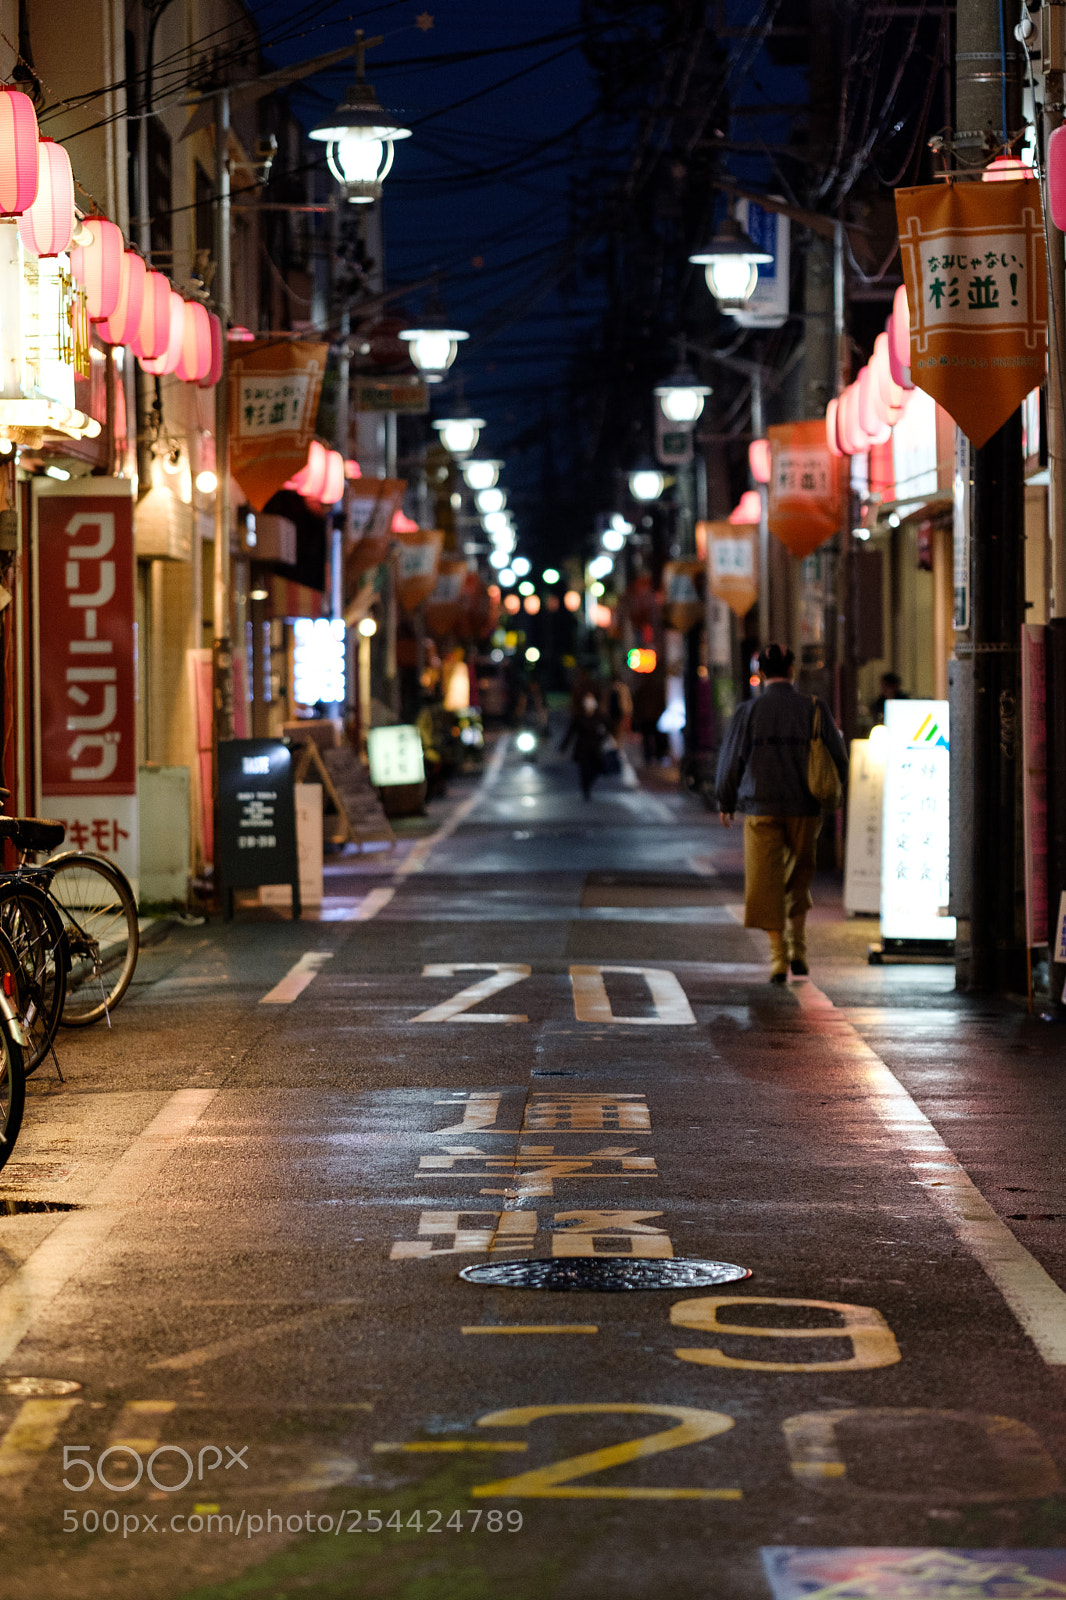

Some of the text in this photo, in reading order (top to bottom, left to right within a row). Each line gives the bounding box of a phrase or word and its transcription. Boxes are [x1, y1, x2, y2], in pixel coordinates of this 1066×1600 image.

[928, 252, 1024, 272] なみじゃない、
[928, 272, 1018, 309] 杉並!
[65, 512, 121, 781] クリーニング
[410, 963, 697, 1026] 20
